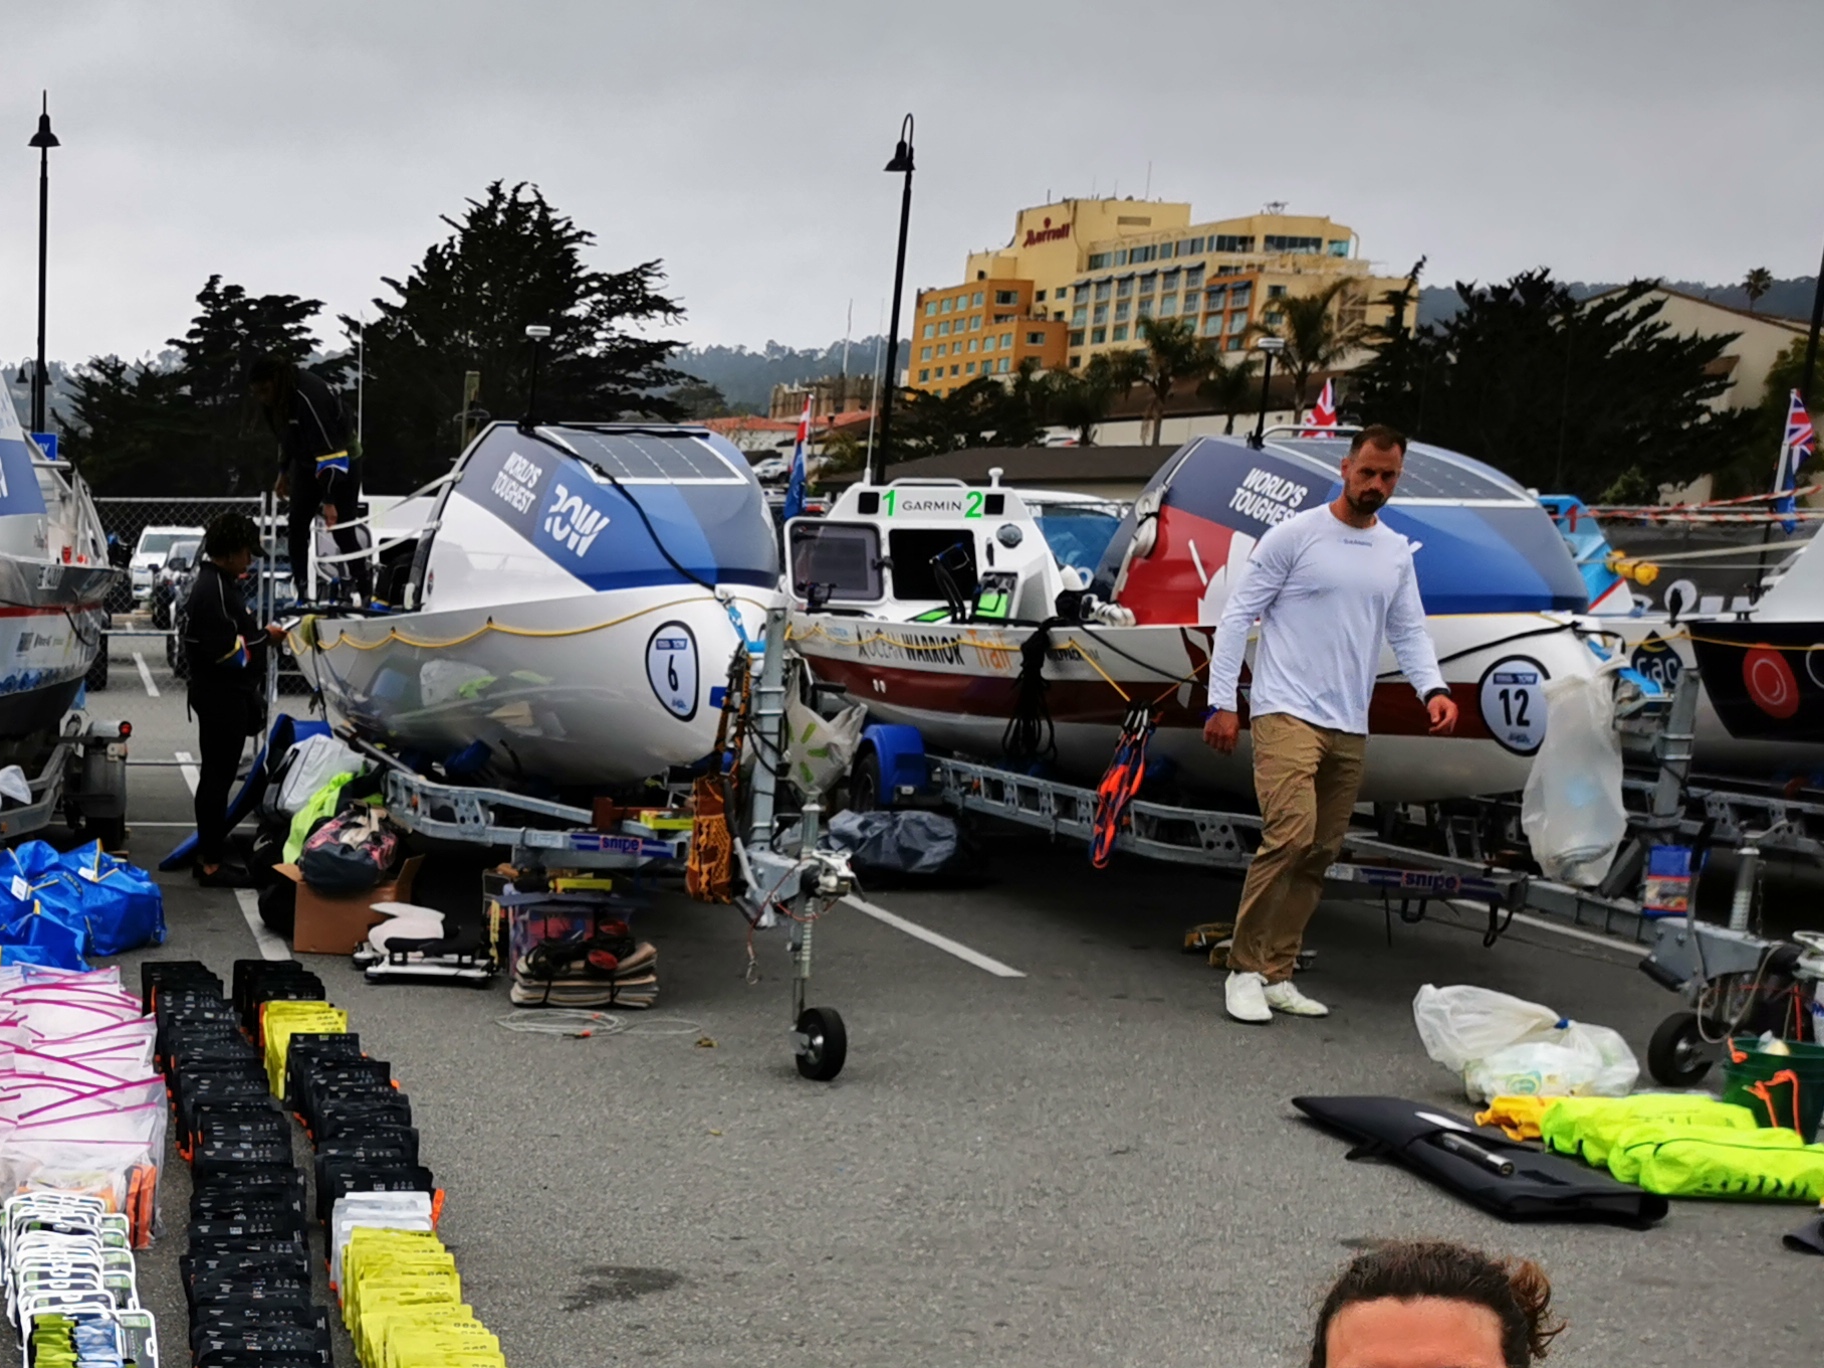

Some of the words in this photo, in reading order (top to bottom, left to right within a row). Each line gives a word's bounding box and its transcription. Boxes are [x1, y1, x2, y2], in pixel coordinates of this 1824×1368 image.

[503, 451, 543, 489] WORLD'S
[1242, 467, 1308, 508] WORLD'S
[491, 471, 536, 514] TOUGHEST
[882, 490, 896, 516] 1
[902, 500, 962, 512] GARMIN
[964, 491, 983, 518] 2
[1228, 487, 1297, 527] TOUGHES
[544, 484, 610, 558] ROW
[901, 632, 965, 666] WARRIOR
[667, 654, 679, 692] 6
[1498, 688, 1531, 727] 12
[602, 836, 640, 853] snipe
[1405, 872, 1458, 891] snipe
